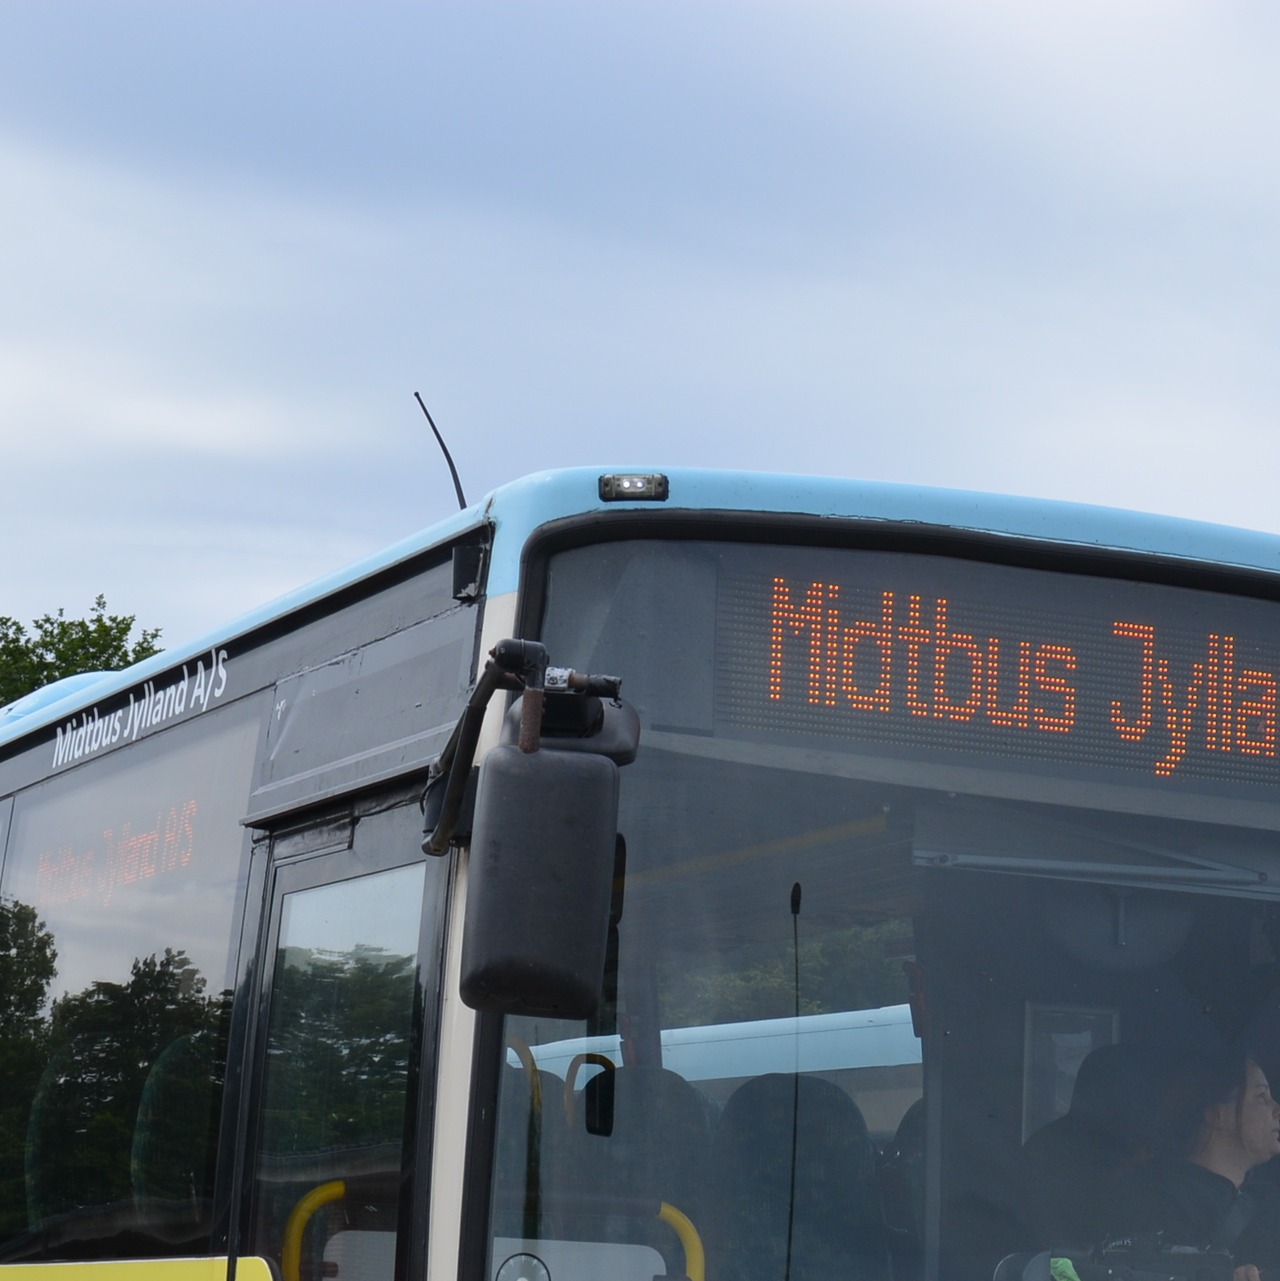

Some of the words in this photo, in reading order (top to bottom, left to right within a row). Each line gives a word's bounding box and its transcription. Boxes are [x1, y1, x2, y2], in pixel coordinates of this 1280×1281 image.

[52, 706, 123, 768] Midtbus
[123, 665, 189, 741] Jylland
[190, 648, 228, 712] A/S
[768, 576, 1077, 734] Midtbus
